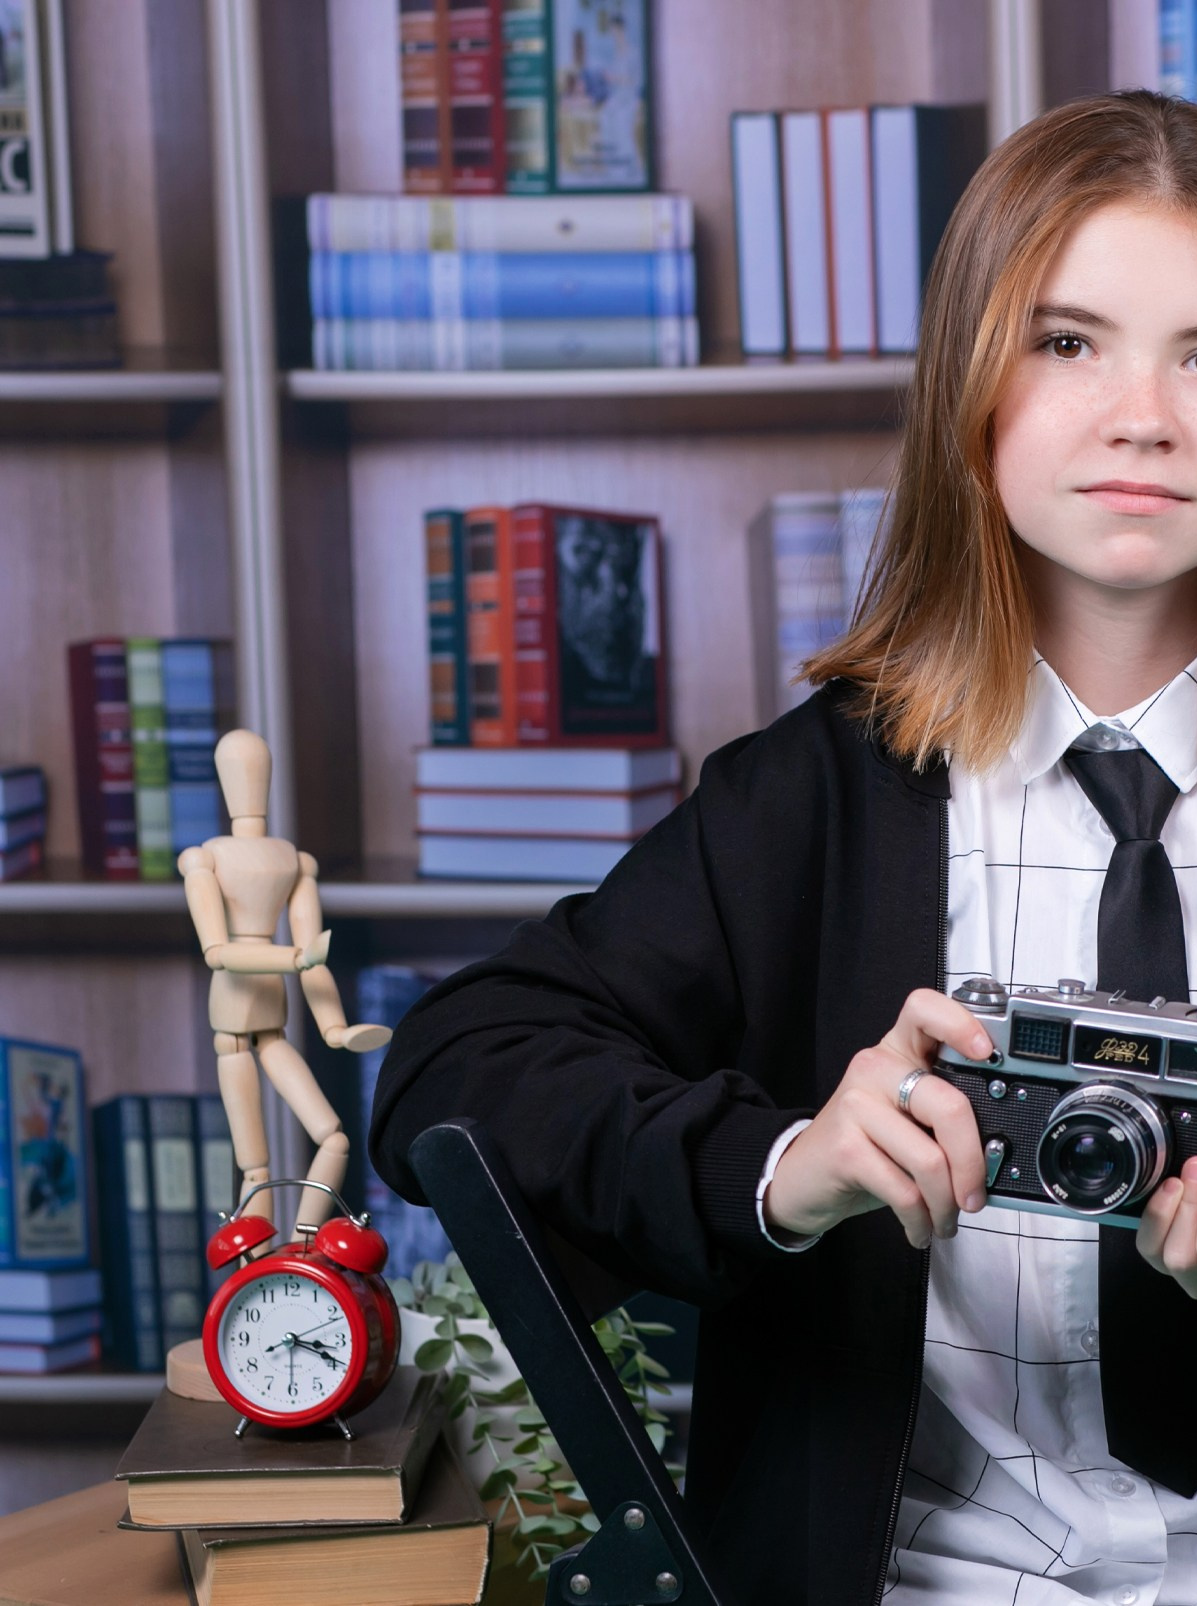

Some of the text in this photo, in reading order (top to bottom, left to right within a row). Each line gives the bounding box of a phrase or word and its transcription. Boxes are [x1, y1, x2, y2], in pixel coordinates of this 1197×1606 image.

[262, 1289, 276, 1303] 11
[284, 1283, 300, 1297] 12
[313, 1290, 318, 1302] 1
[246, 1308, 261, 1323] 10
[328, 1305, 338, 1320] 2
[239, 1331, 250, 1347] 9
[335, 1332, 346, 1347] 3
[247, 1357, 258, 1373] 8
[264, 1375, 274, 1391] 7
[288, 1383, 298, 1397] 6
[312, 1377, 323, 1391] 5
